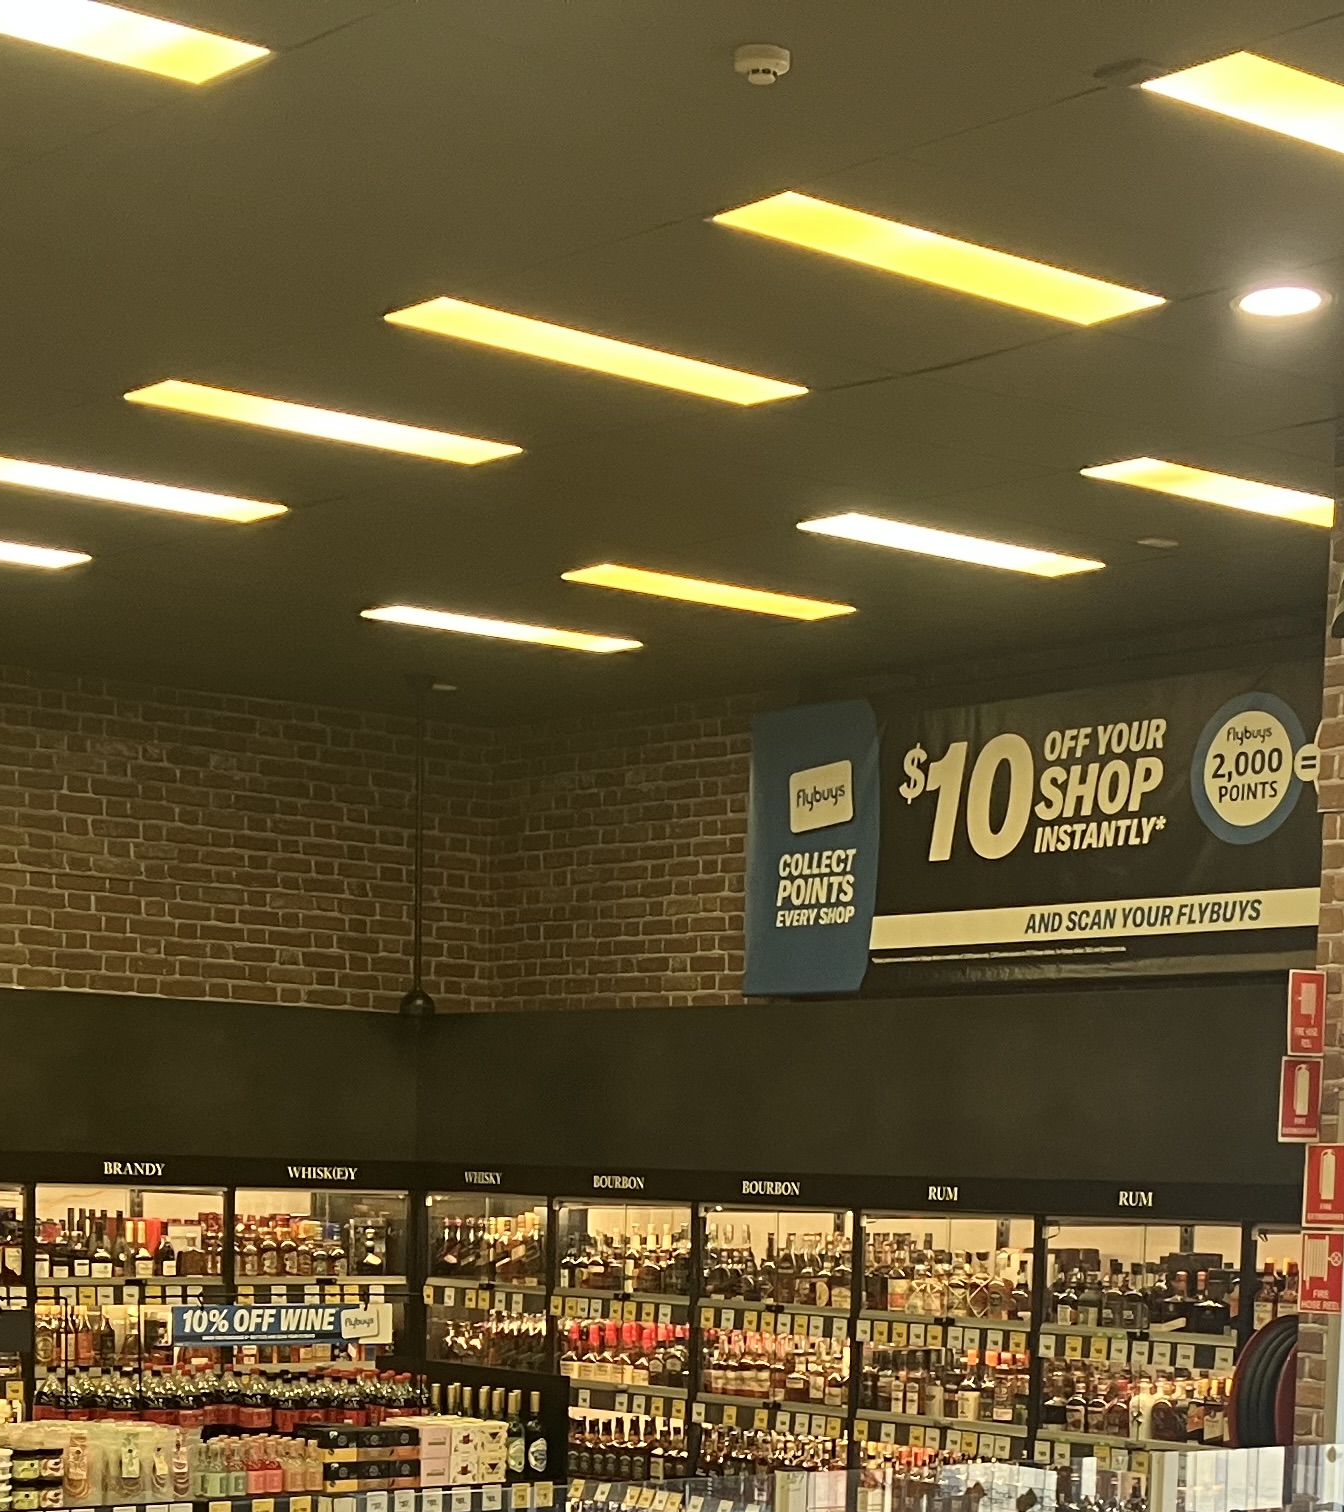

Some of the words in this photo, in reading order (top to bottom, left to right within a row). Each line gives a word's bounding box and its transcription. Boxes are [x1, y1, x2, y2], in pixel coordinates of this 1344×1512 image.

[1043, 727, 1090, 762] OFF
[1098, 719, 1166, 755] YOUR
[1226, 725, 1273, 746] flybuys
[1211, 747, 1283, 780] 2,000
[796, 782, 846, 809] flybuys
[898, 733, 1034, 862] $10
[1035, 756, 1163, 821] SHOP
[1218, 781, 1278, 803] POINTS
[778, 848, 857, 878] COLLECT
[776, 874, 854, 907] POINTS
[776, 907, 815, 928] EVERY
[819, 905, 855, 926] SHOP
[1024, 913, 1062, 935] AND
[1065, 909, 1118, 932] SCAN
[1121, 905, 1173, 929] YOUR
[1177, 899, 1262, 927] FLYBUYS
[103, 1161, 165, 1177] BRANDY
[287, 1166, 358, 1182] WHISK(E)Y
[464, 1171, 502, 1185] WHISKY
[593, 1175, 645, 1190] BOURBON
[742, 1180, 800, 1196] BOURBON
[927, 1186, 959, 1202] RUM
[1118, 1191, 1153, 1207] RUM
[1313, 1289, 1329, 1299] FIRE
[183, 1308, 229, 1333] 10%
[234, 1308, 275, 1333] OFF
